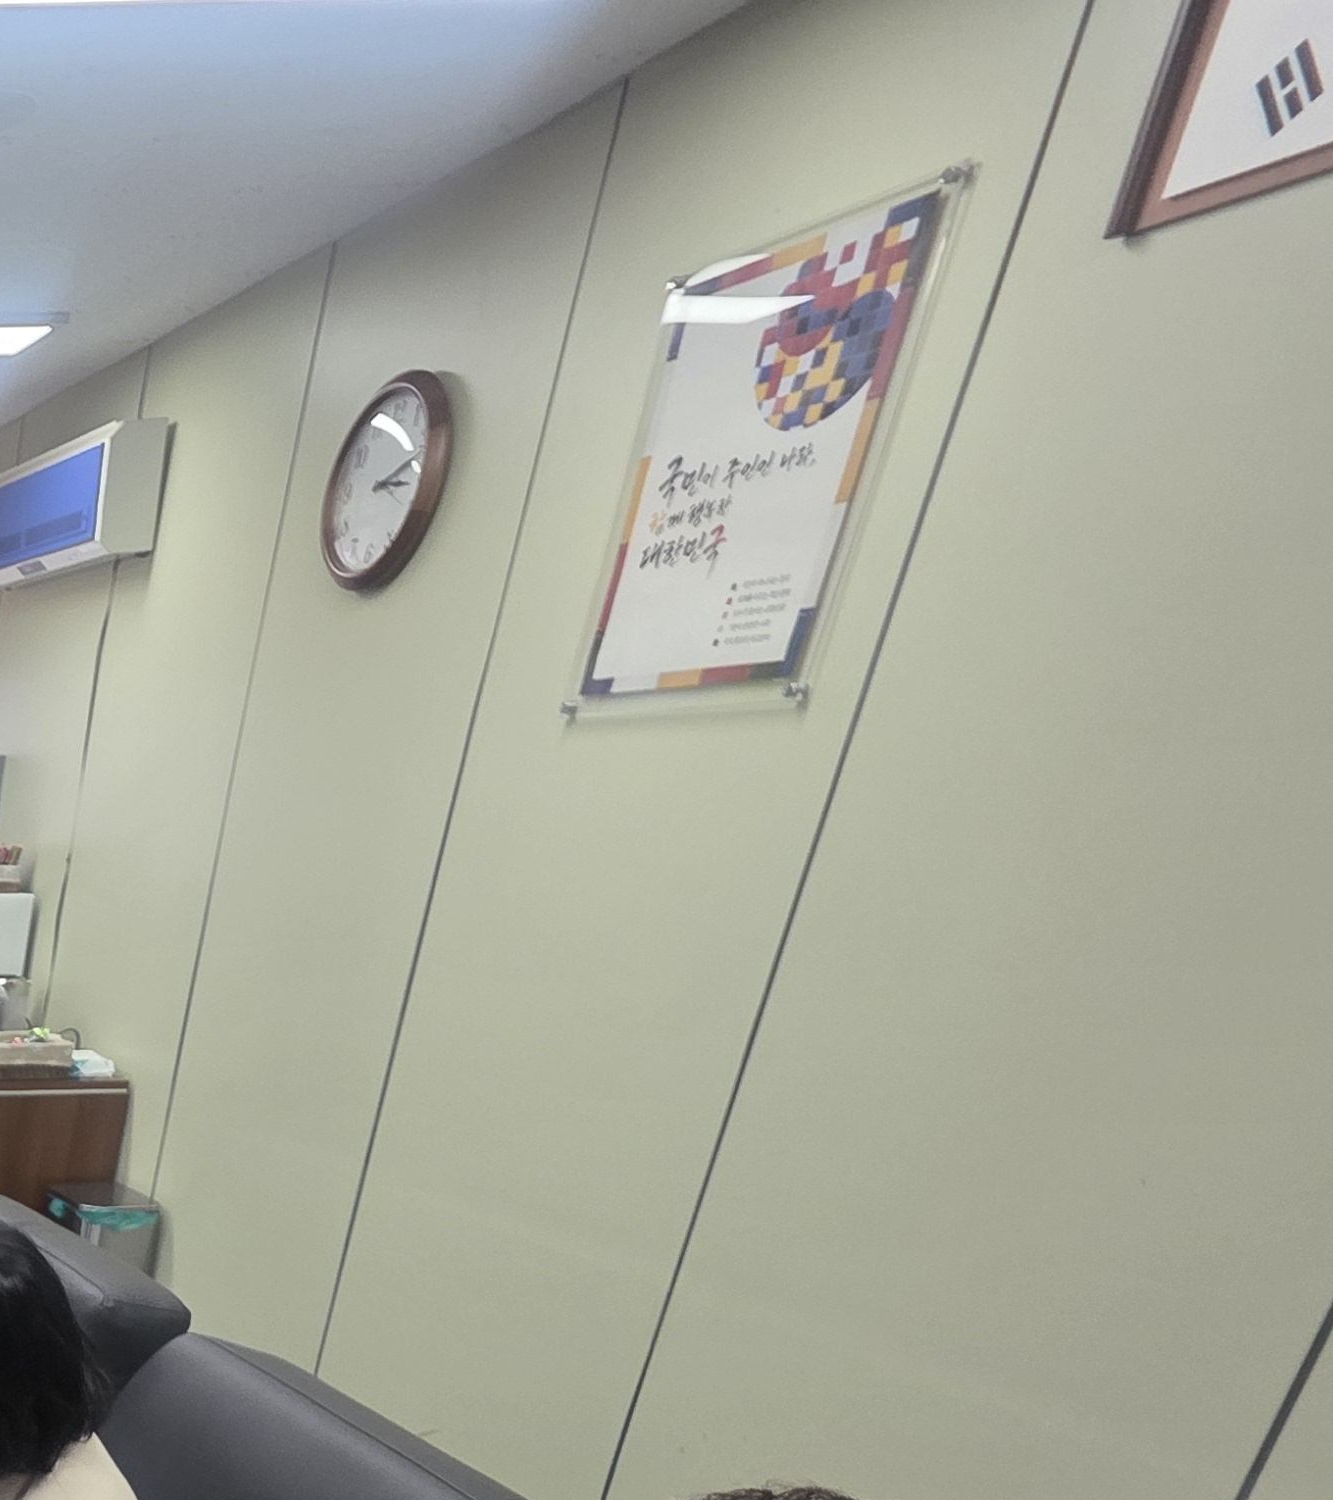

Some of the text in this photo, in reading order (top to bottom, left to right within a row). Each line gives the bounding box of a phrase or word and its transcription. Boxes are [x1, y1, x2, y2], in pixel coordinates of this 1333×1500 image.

[659, 455, 720, 509] 국민이
[721, 450, 776, 489] 주인인
[639, 523, 728, 580] 대한민국
